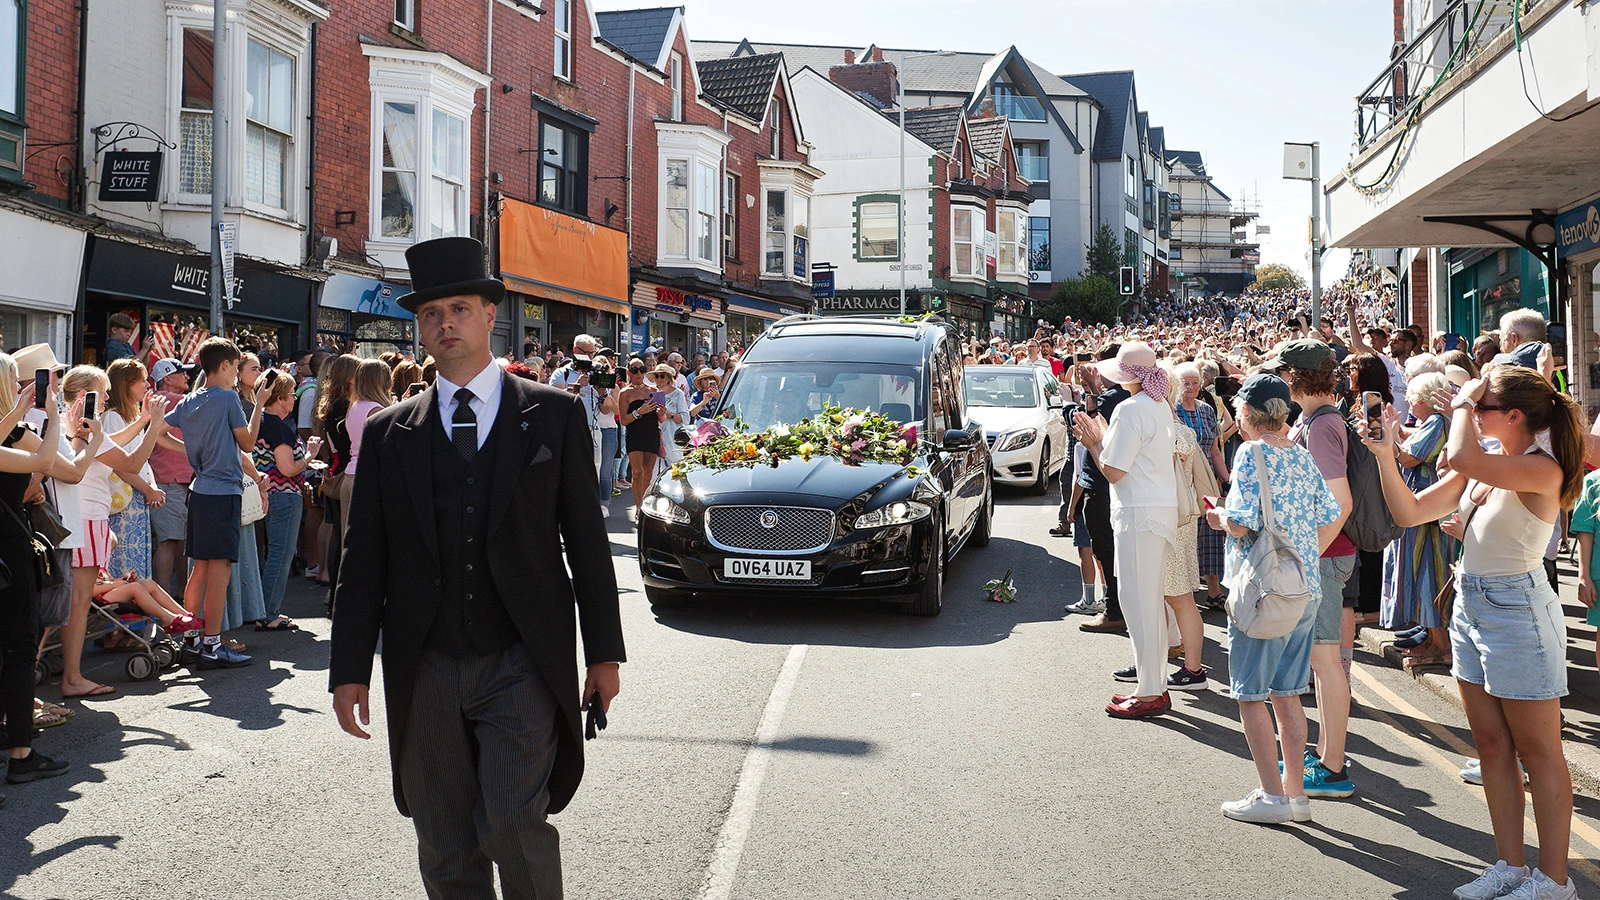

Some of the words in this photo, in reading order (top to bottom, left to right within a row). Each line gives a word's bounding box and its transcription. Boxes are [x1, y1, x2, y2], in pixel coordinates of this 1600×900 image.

[113, 160, 151, 171] WHITE
[110, 176, 148, 188] STUFF
[174, 263, 209, 288] WHITE
[655, 287, 685, 305] TESCO
[822, 296, 910, 309] PHARMACY
[732, 560, 771, 576] OV64
[775, 561, 805, 576] UAZ
